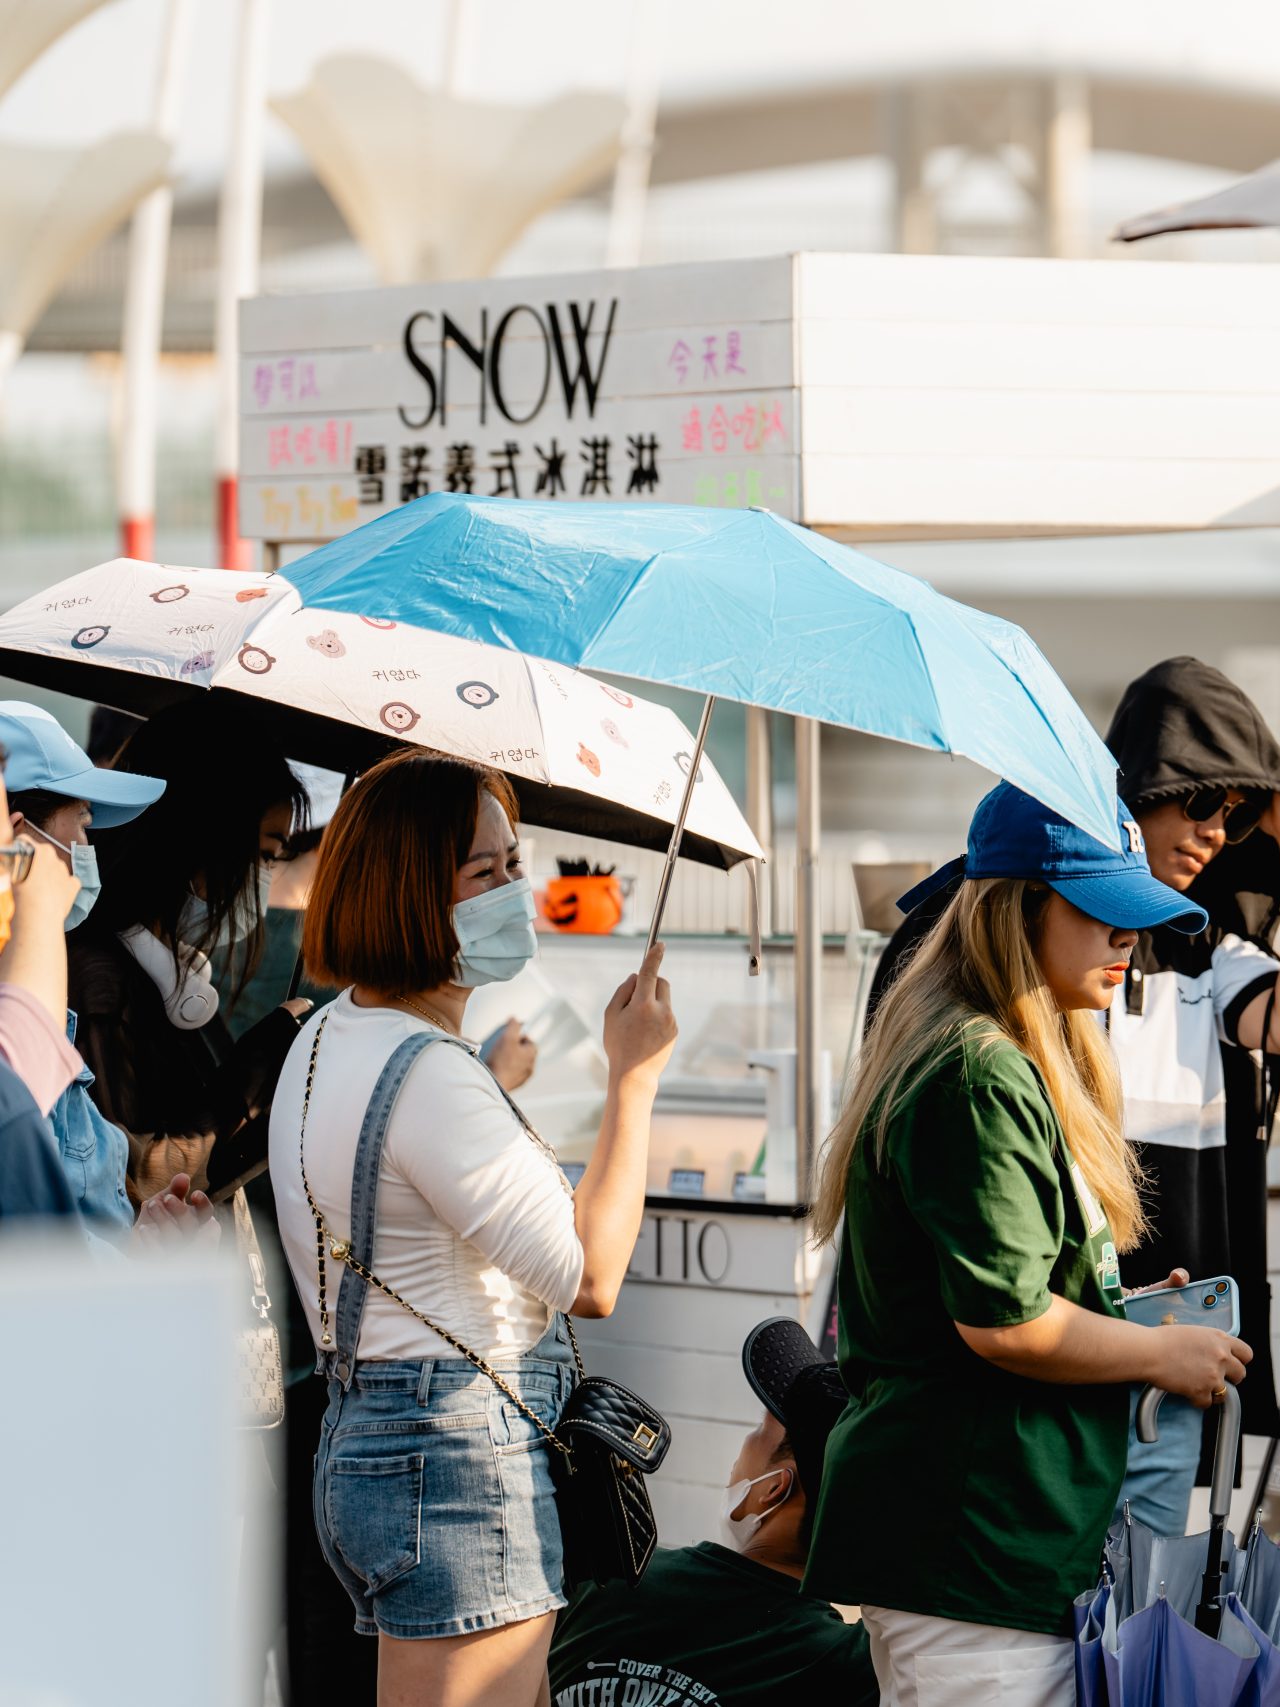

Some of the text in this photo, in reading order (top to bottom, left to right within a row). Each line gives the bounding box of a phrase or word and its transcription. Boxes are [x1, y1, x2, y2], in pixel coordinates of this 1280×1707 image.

[398, 298, 618, 429] SNOW
[372, 669, 422, 682] 귀엽다
[490, 747, 540, 763] 귀엽다
[625, 1213, 732, 1287] TTO
[555, 1677, 620, 1707] WITH
[622, 1678, 682, 1707] ONLY
[618, 1658, 662, 1679] COVER
[665, 1668, 693, 1691] THE
[689, 1682, 718, 1704] SKY
